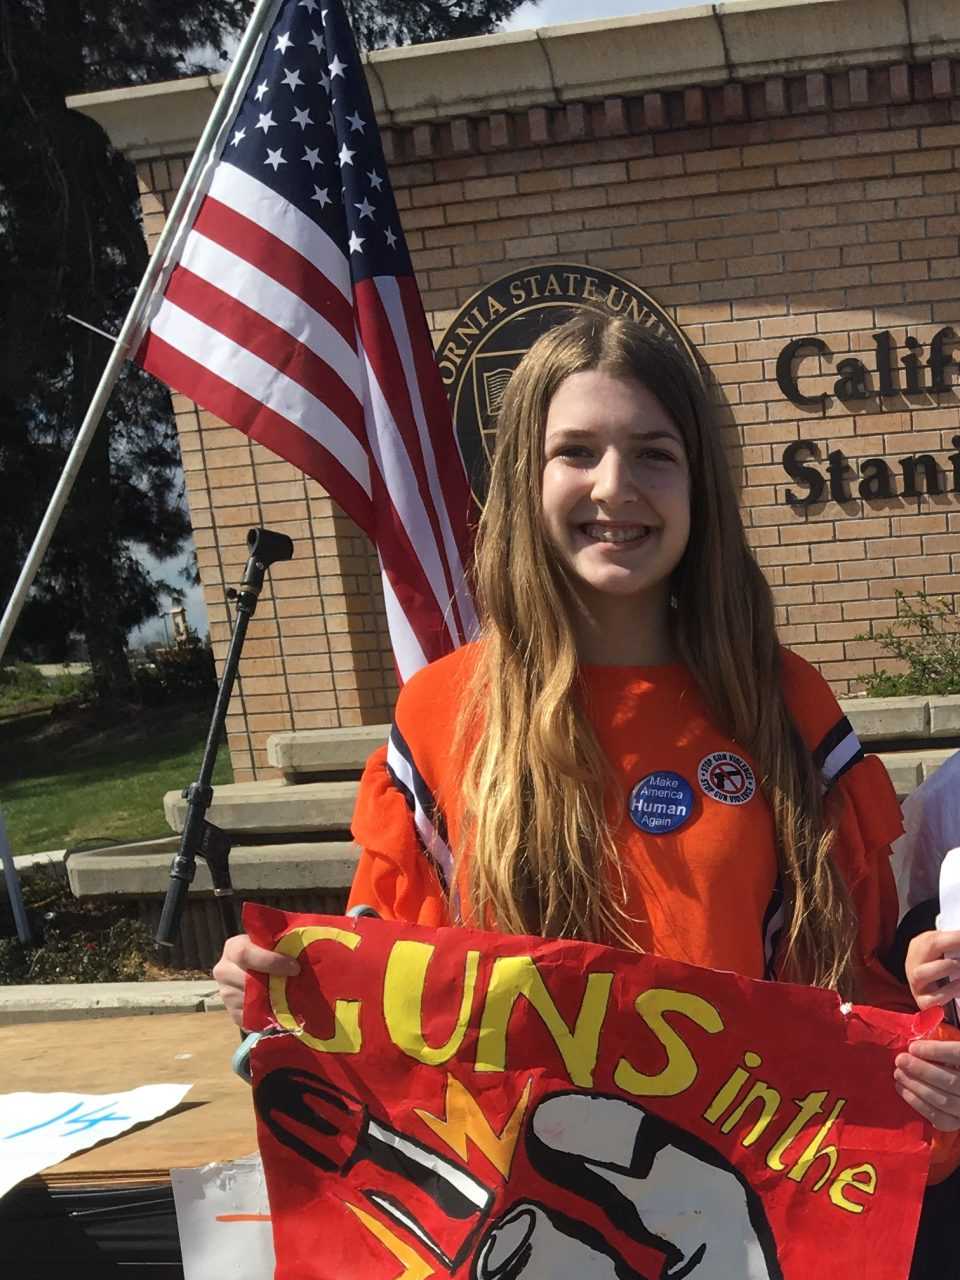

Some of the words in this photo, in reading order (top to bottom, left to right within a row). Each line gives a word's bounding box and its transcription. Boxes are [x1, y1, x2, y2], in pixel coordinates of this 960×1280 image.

[438, 296, 507, 398] ORNIA
[509, 273, 599, 304] STATE
[650, 776, 679, 788] Make
[640, 787, 683, 800] America
[632, 799, 687, 816] Human
[642, 814, 672, 827] Again
[266, 925, 726, 1096] GUNS
